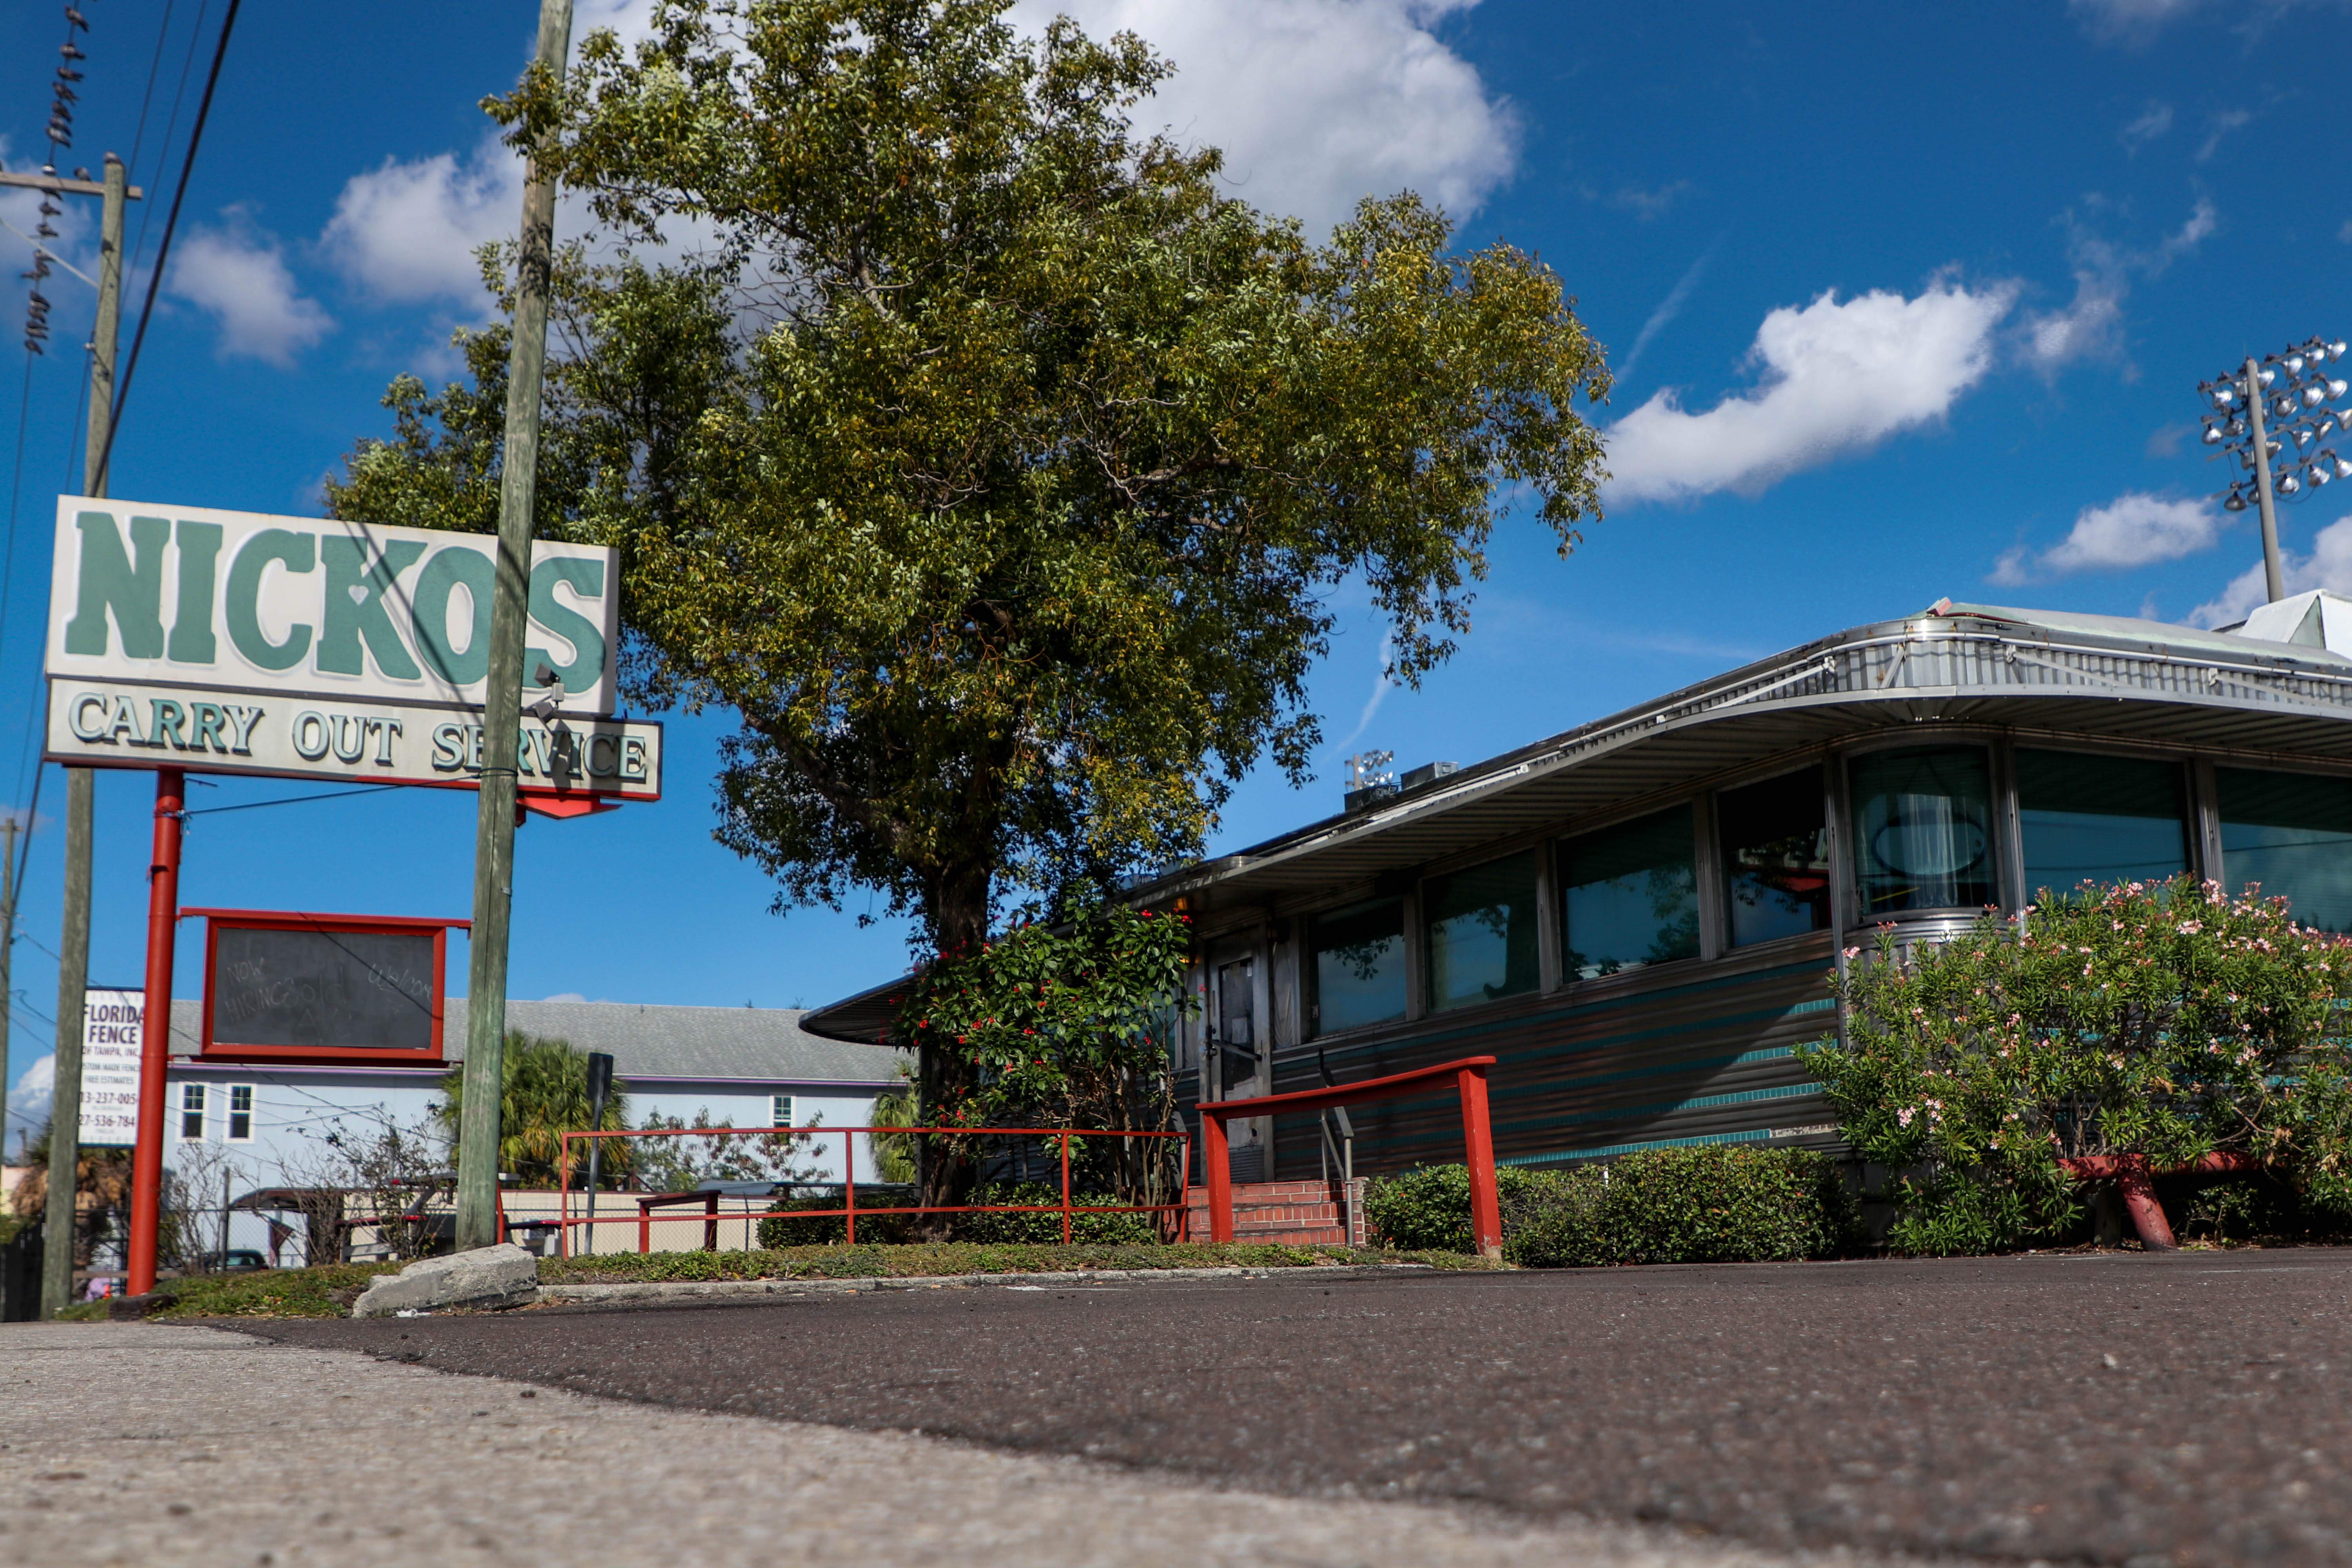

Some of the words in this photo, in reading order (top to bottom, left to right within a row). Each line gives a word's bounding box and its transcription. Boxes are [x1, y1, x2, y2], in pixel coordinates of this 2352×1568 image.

[65, 511, 606, 693] NICKOS
[69, 692, 265, 756] CARRY
[292, 710, 402, 766] OUT
[89, 1025, 137, 1044] FENCE
